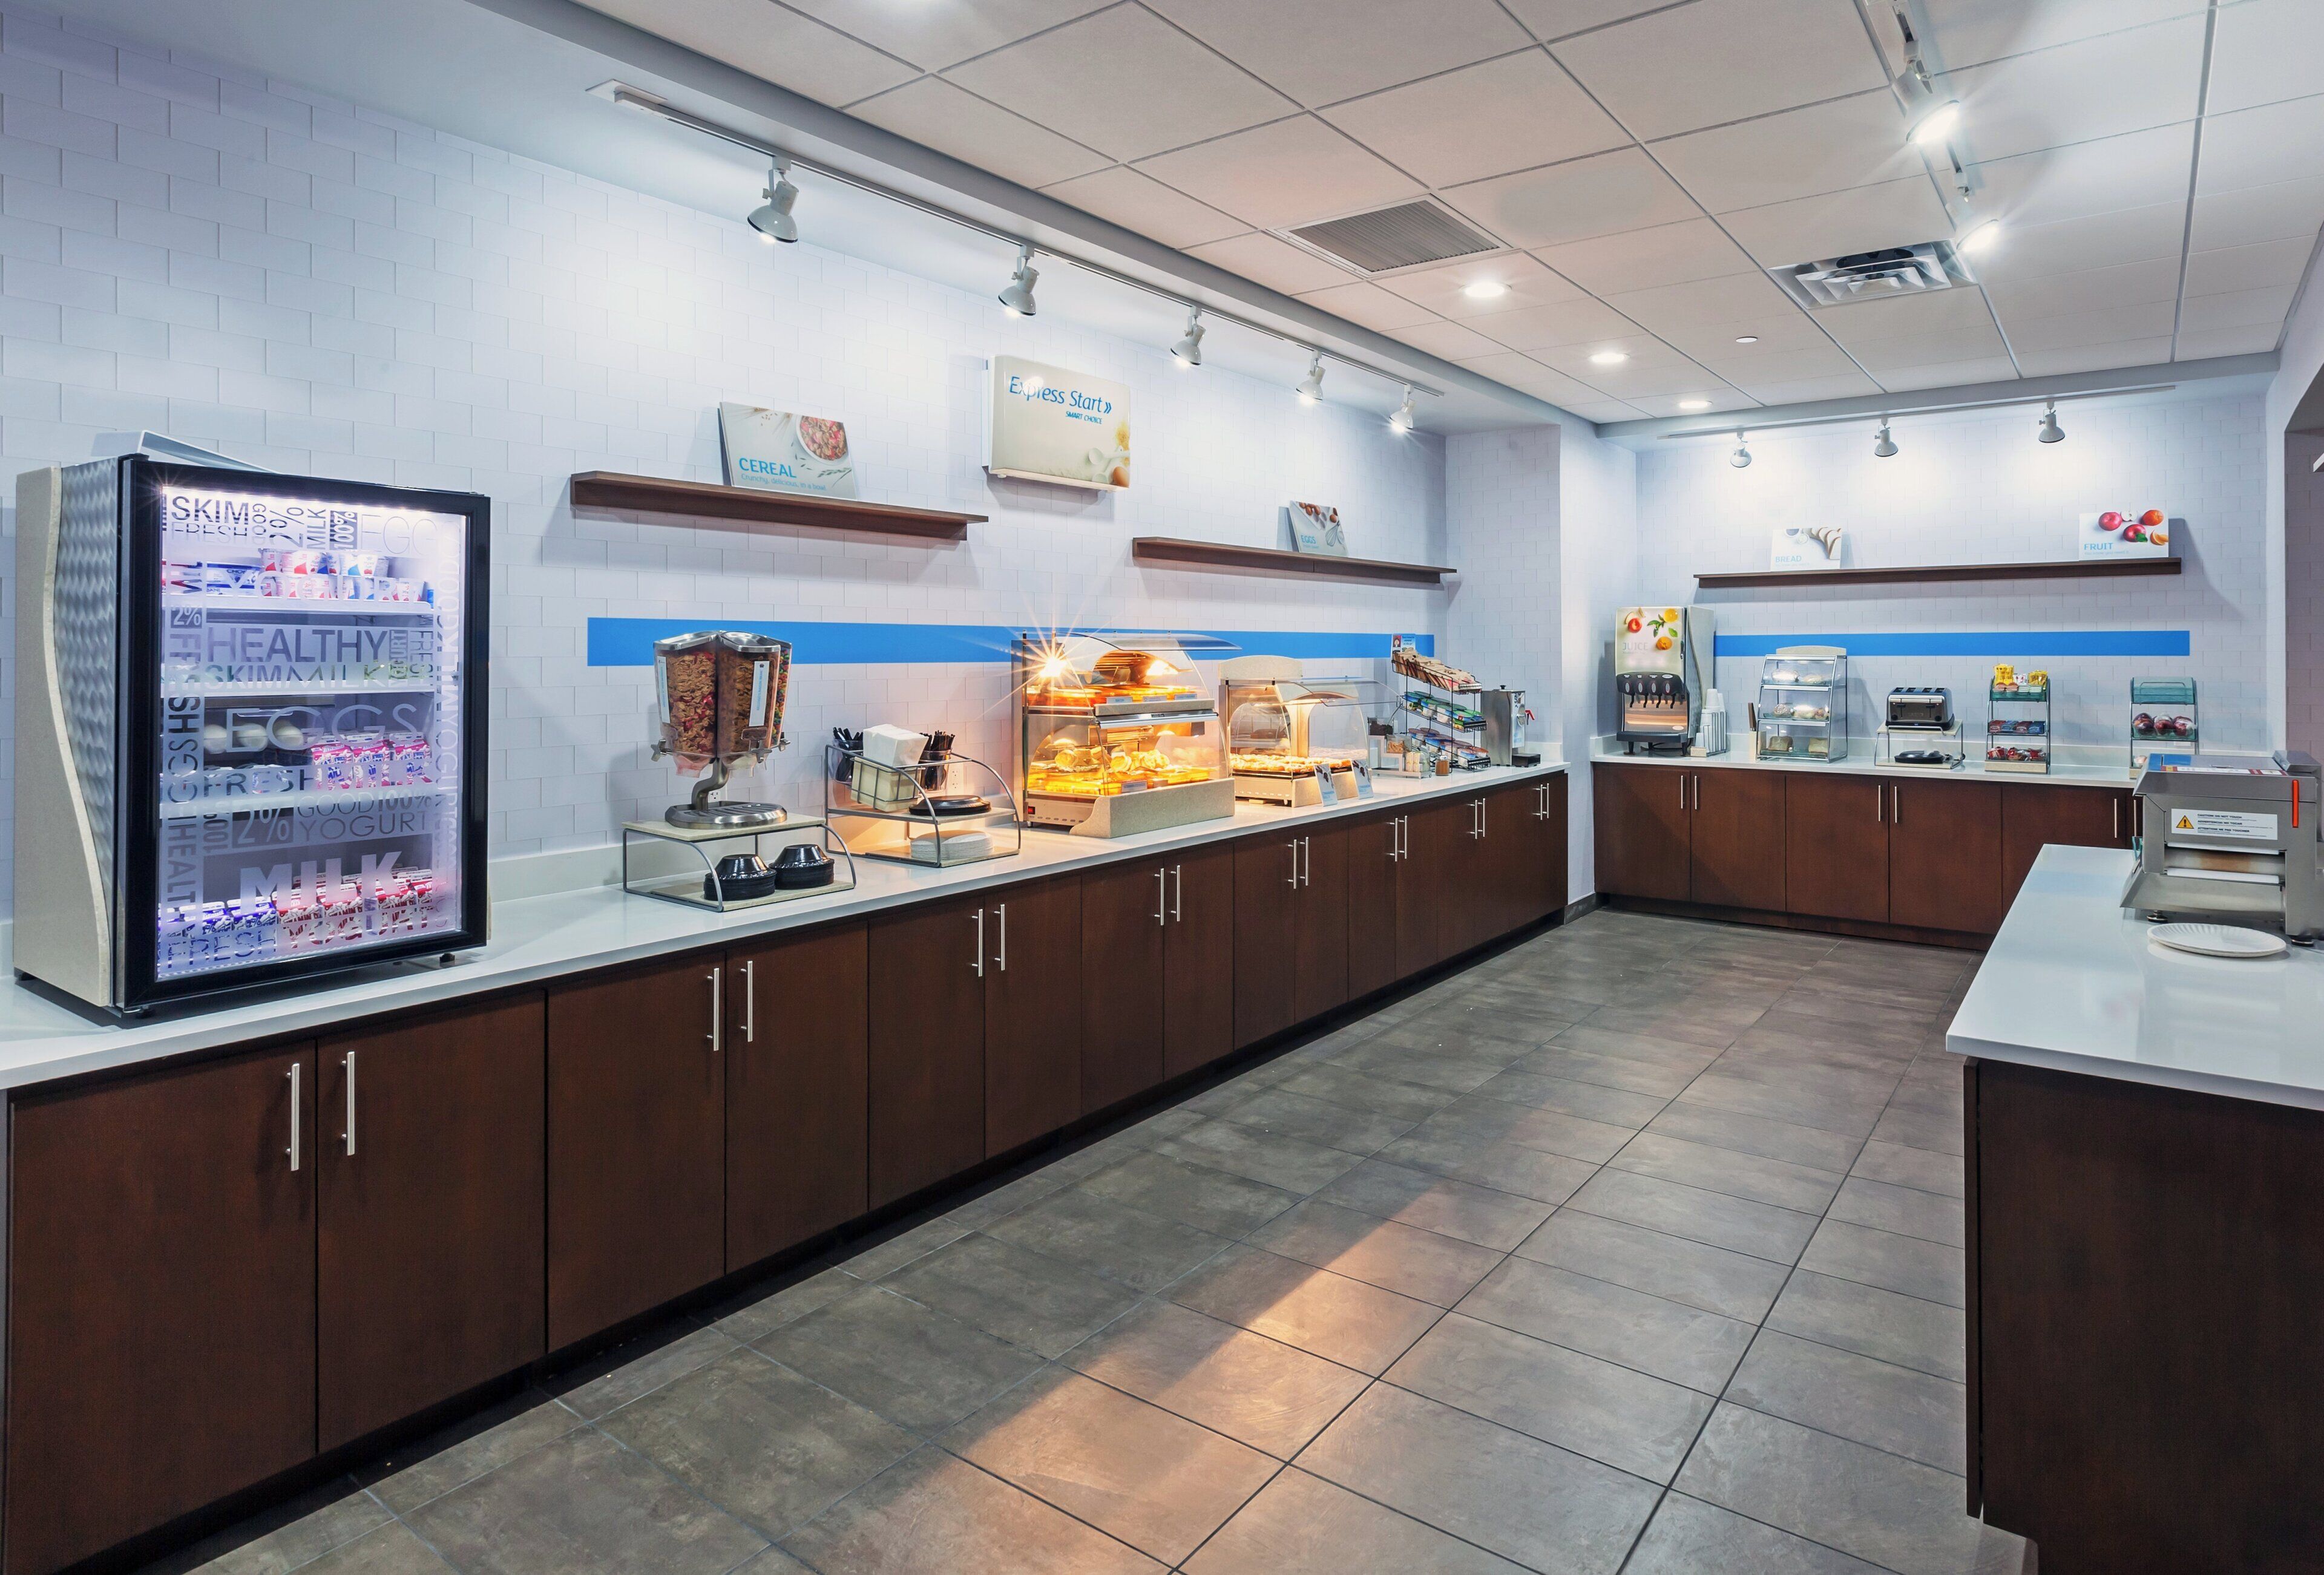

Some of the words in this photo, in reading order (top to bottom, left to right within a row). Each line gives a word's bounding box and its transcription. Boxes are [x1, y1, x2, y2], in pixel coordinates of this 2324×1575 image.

[1009, 375, 1065, 404] Express
[1069, 390, 1103, 413] Start
[1065, 410, 1083, 420] SMART
[1083, 414, 1103, 424] CHOICE
[738, 457, 797, 478] CEREAL
[171, 496, 249, 525] SKIM
[252, 503, 267, 545] GOOD
[269, 506, 305, 548] 2%
[171, 522, 249, 545] FRESH
[307, 508, 326, 550] MILK
[332, 511, 357, 549] 100%
[1301, 534, 1316, 544] EGGS
[2084, 542, 2113, 551] FRUIT
[172, 606, 202, 626] 2%
[207, 627, 388, 663] HEALTHY
[1622, 642, 1649, 651] JUICE
[436, 630, 459, 712] MILK
[226, 704, 418, 753] EGGS
[167, 738, 199, 820] EGGS
[297, 791, 375, 817] GOOD
[377, 789, 432, 813] 100%
[237, 804, 290, 845] 2%
[298, 810, 430, 842] YOGURT
[240, 851, 402, 915] MILK
[167, 928, 278, 969] FRESH
